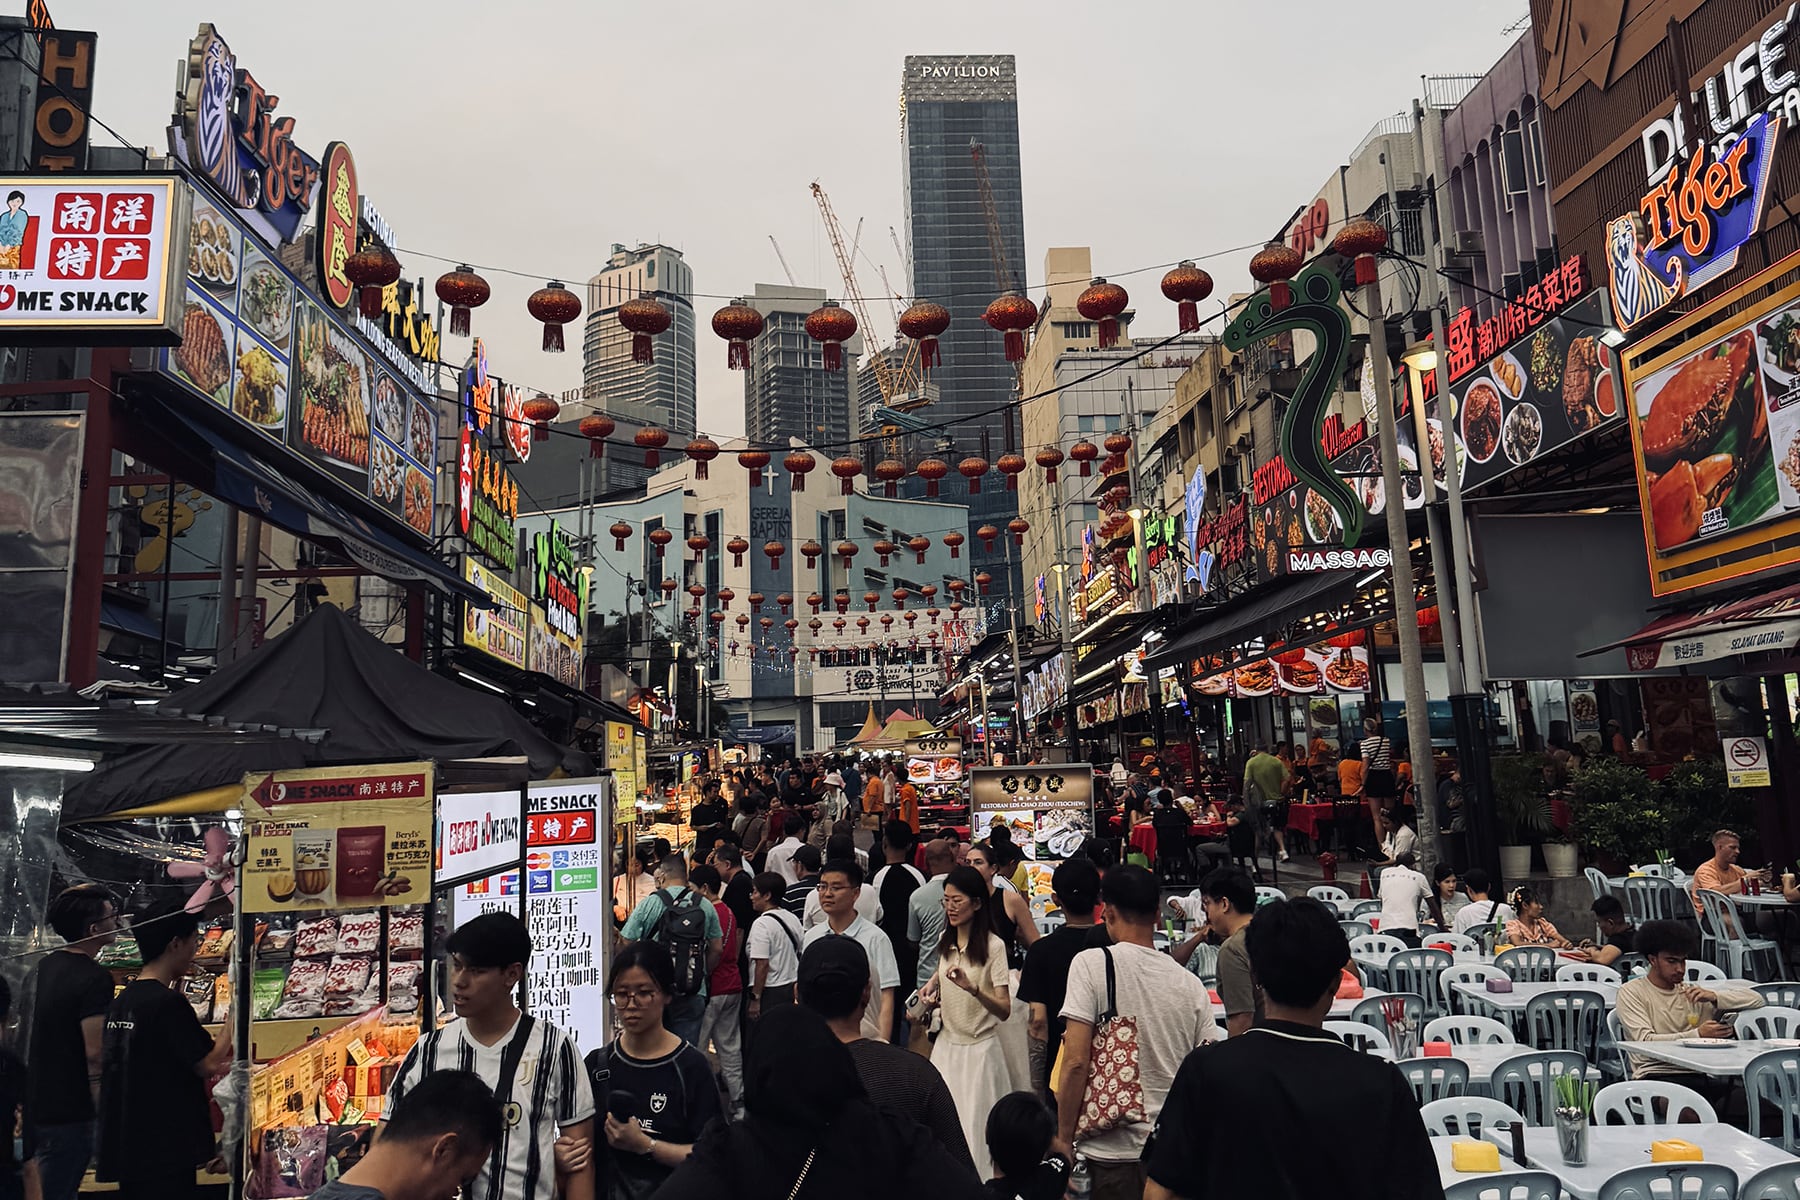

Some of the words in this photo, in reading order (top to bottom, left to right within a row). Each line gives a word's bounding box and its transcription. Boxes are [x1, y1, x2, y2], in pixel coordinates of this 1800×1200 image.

[922, 66, 1000, 78] PAVILION
[236, 69, 320, 213] Tiger
[1641, 138, 1749, 257] Tiger
[60, 195, 147, 232] 南洋
[55, 241, 144, 276] 特产
[59, 291, 149, 315] SNACK
[751, 507, 791, 520] GEREJA
[751, 521, 791, 538] BAPTIST
[1730, 635, 1757, 650] SELAMAT
[1757, 631, 1785, 646] DATANG
[310, 784, 355, 798] SNACK
[359, 780, 420, 796] 南洋特产
[551, 794, 597, 809] SNACK
[482, 812, 499, 846] HOME
[501, 816, 518, 843] SNACK
[387, 850, 430, 860] 杏仁巧克力
[571, 850, 598, 861] 支付宝
